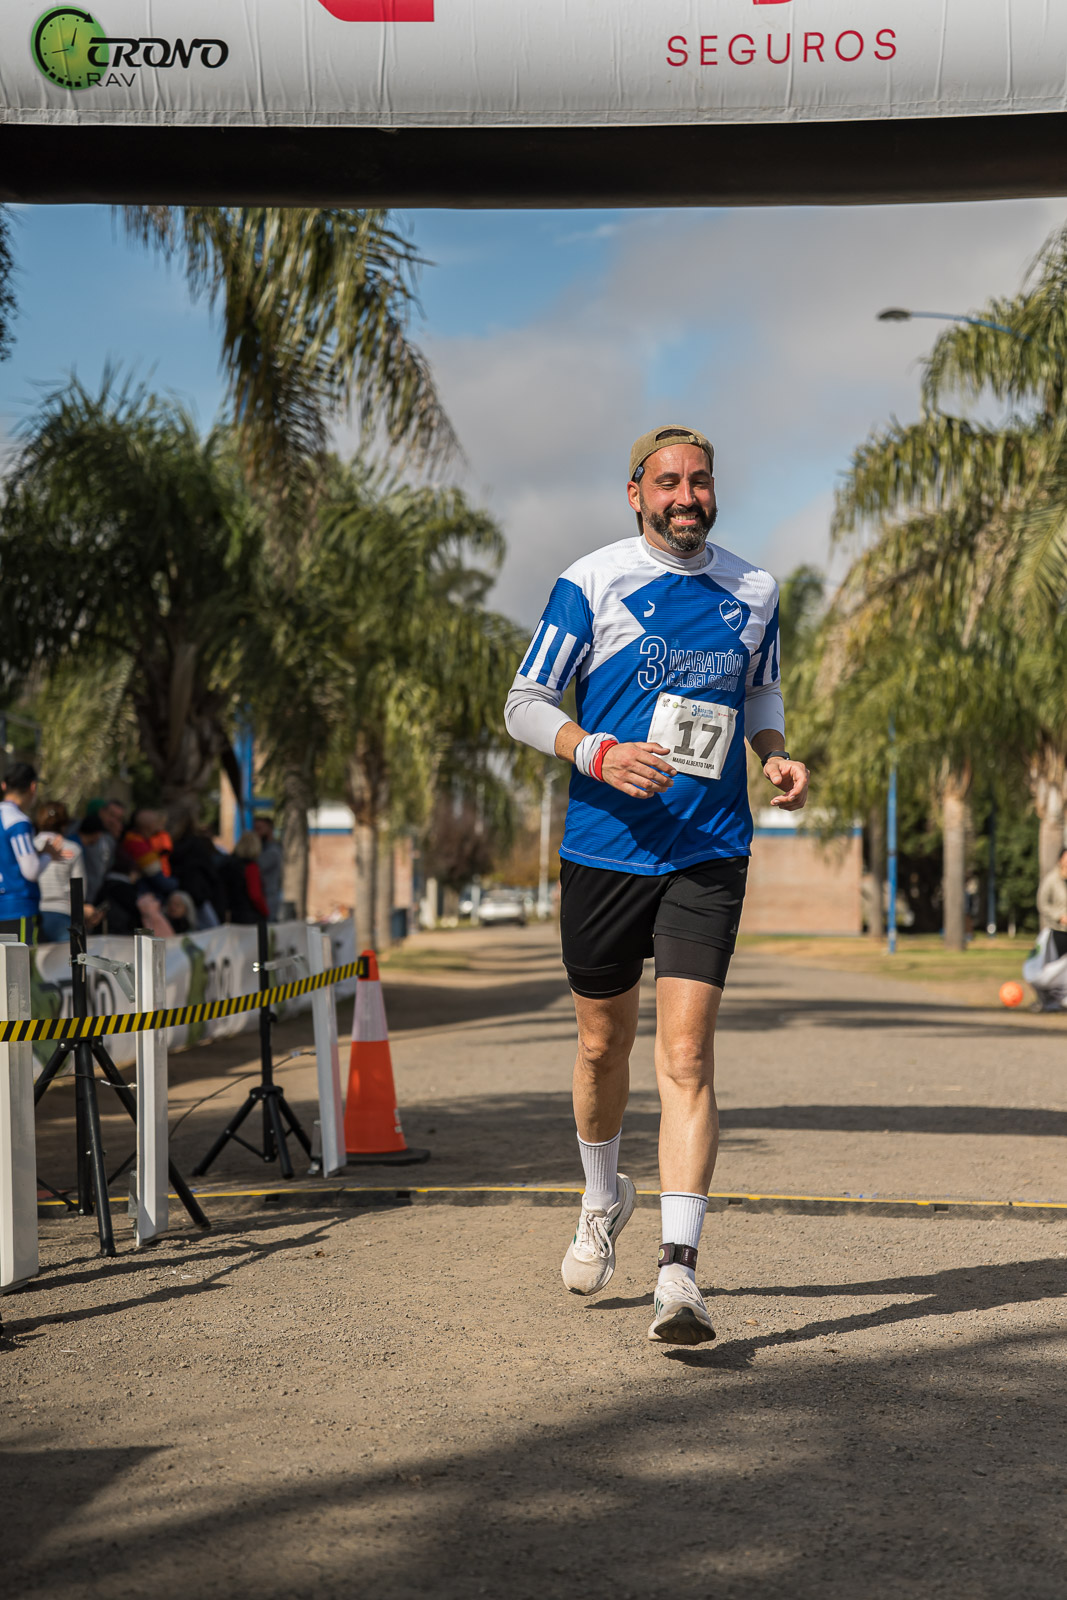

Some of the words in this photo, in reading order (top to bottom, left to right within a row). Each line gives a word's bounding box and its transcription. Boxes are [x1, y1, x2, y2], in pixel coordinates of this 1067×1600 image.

[87, 37, 229, 69] CRONO
[666, 28, 897, 67] SEGUROS
[86, 72, 136, 87] RAV
[637, 635, 667, 691] 3
[669, 649, 744, 676] MARATÓN
[673, 721, 722, 760] 17
[672, 757, 685, 765] MARIO
[685, 760, 703, 768] ALBERTO
[703, 762, 715, 770] TAPIA
